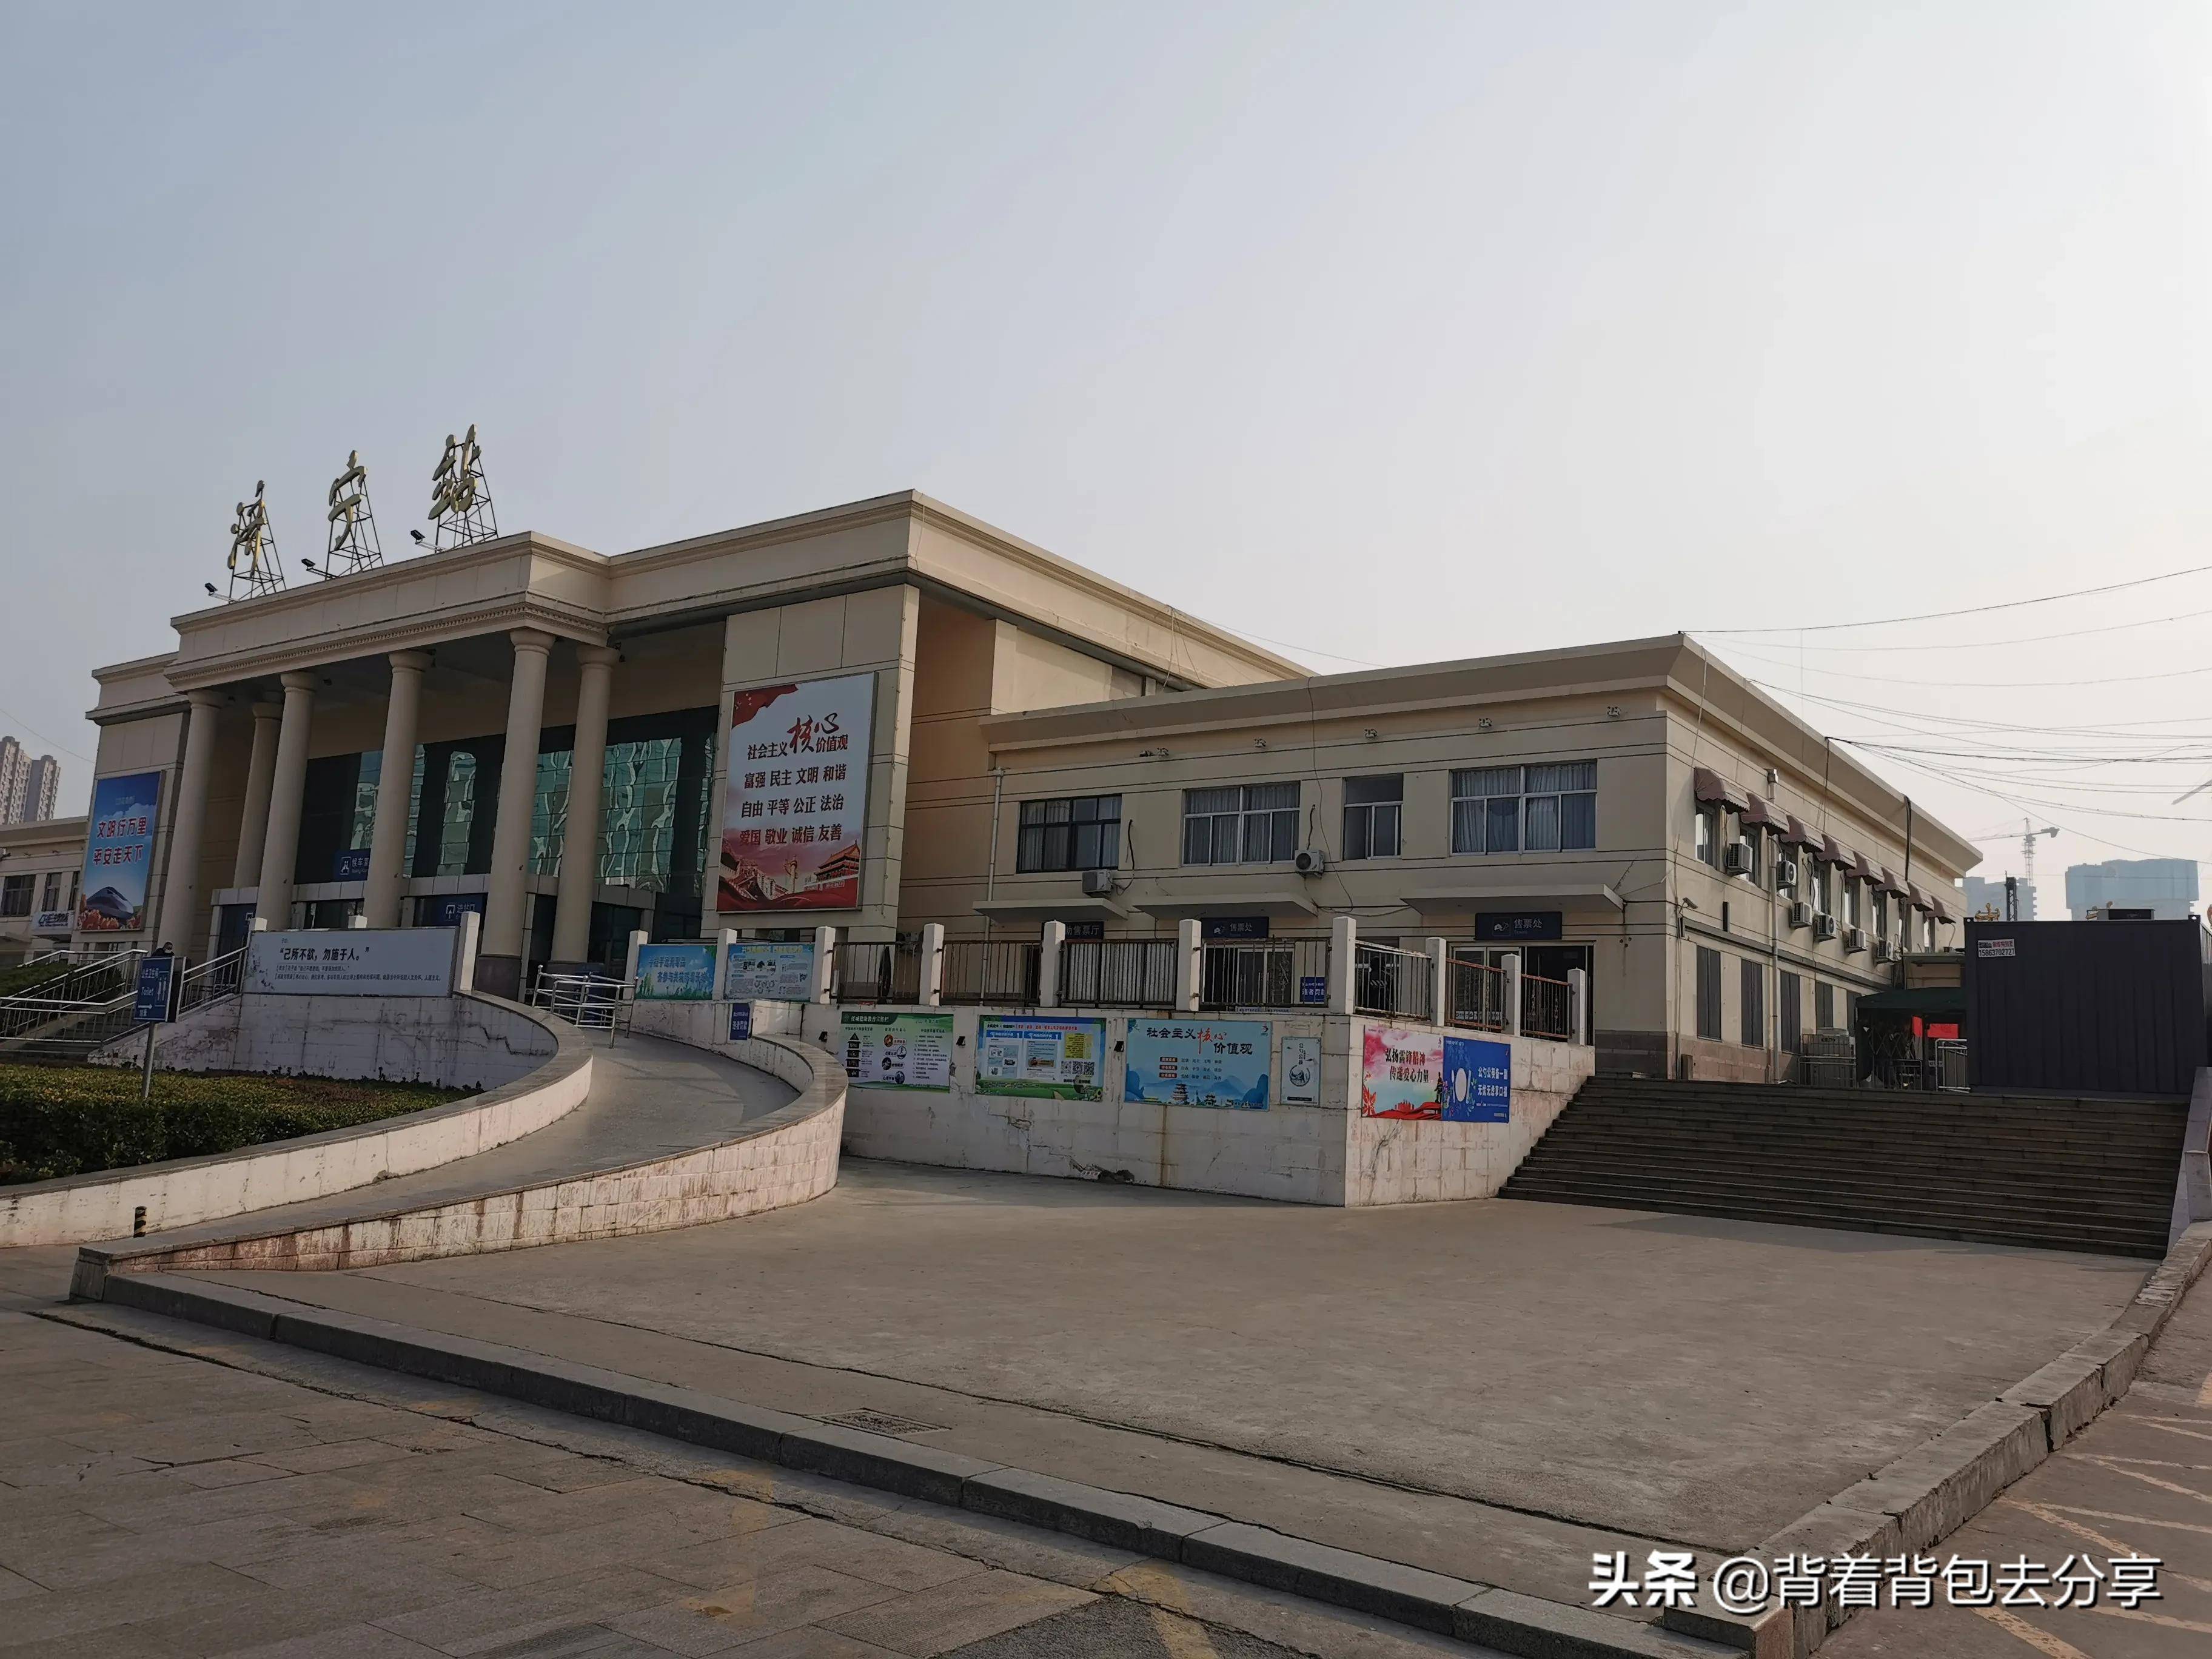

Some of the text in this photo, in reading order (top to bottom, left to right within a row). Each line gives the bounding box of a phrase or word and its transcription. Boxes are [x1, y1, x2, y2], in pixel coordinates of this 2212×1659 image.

[227, 424, 481, 578] 济宁站
[747, 712, 848, 760] 社会主义核心价值观
[744, 763, 847, 789] 富强 民主 文明 和谐
[741, 793, 845, 819] 自由 平等 公正 法治
[97, 816, 147, 838] 文明行万里
[739, 823, 842, 846] 爱国 敬业 诚信 友善
[93, 844, 144, 866] 平安走天下
[1229, 923, 1253, 933] 售票处
[1513, 918, 1543, 929] 售票处
[1214, 1042, 1253, 1055] 价值观
[1386, 1048, 1426, 1065] 弘扬雷锋精神
[1390, 1065, 1429, 1083] 传递爱心力量
